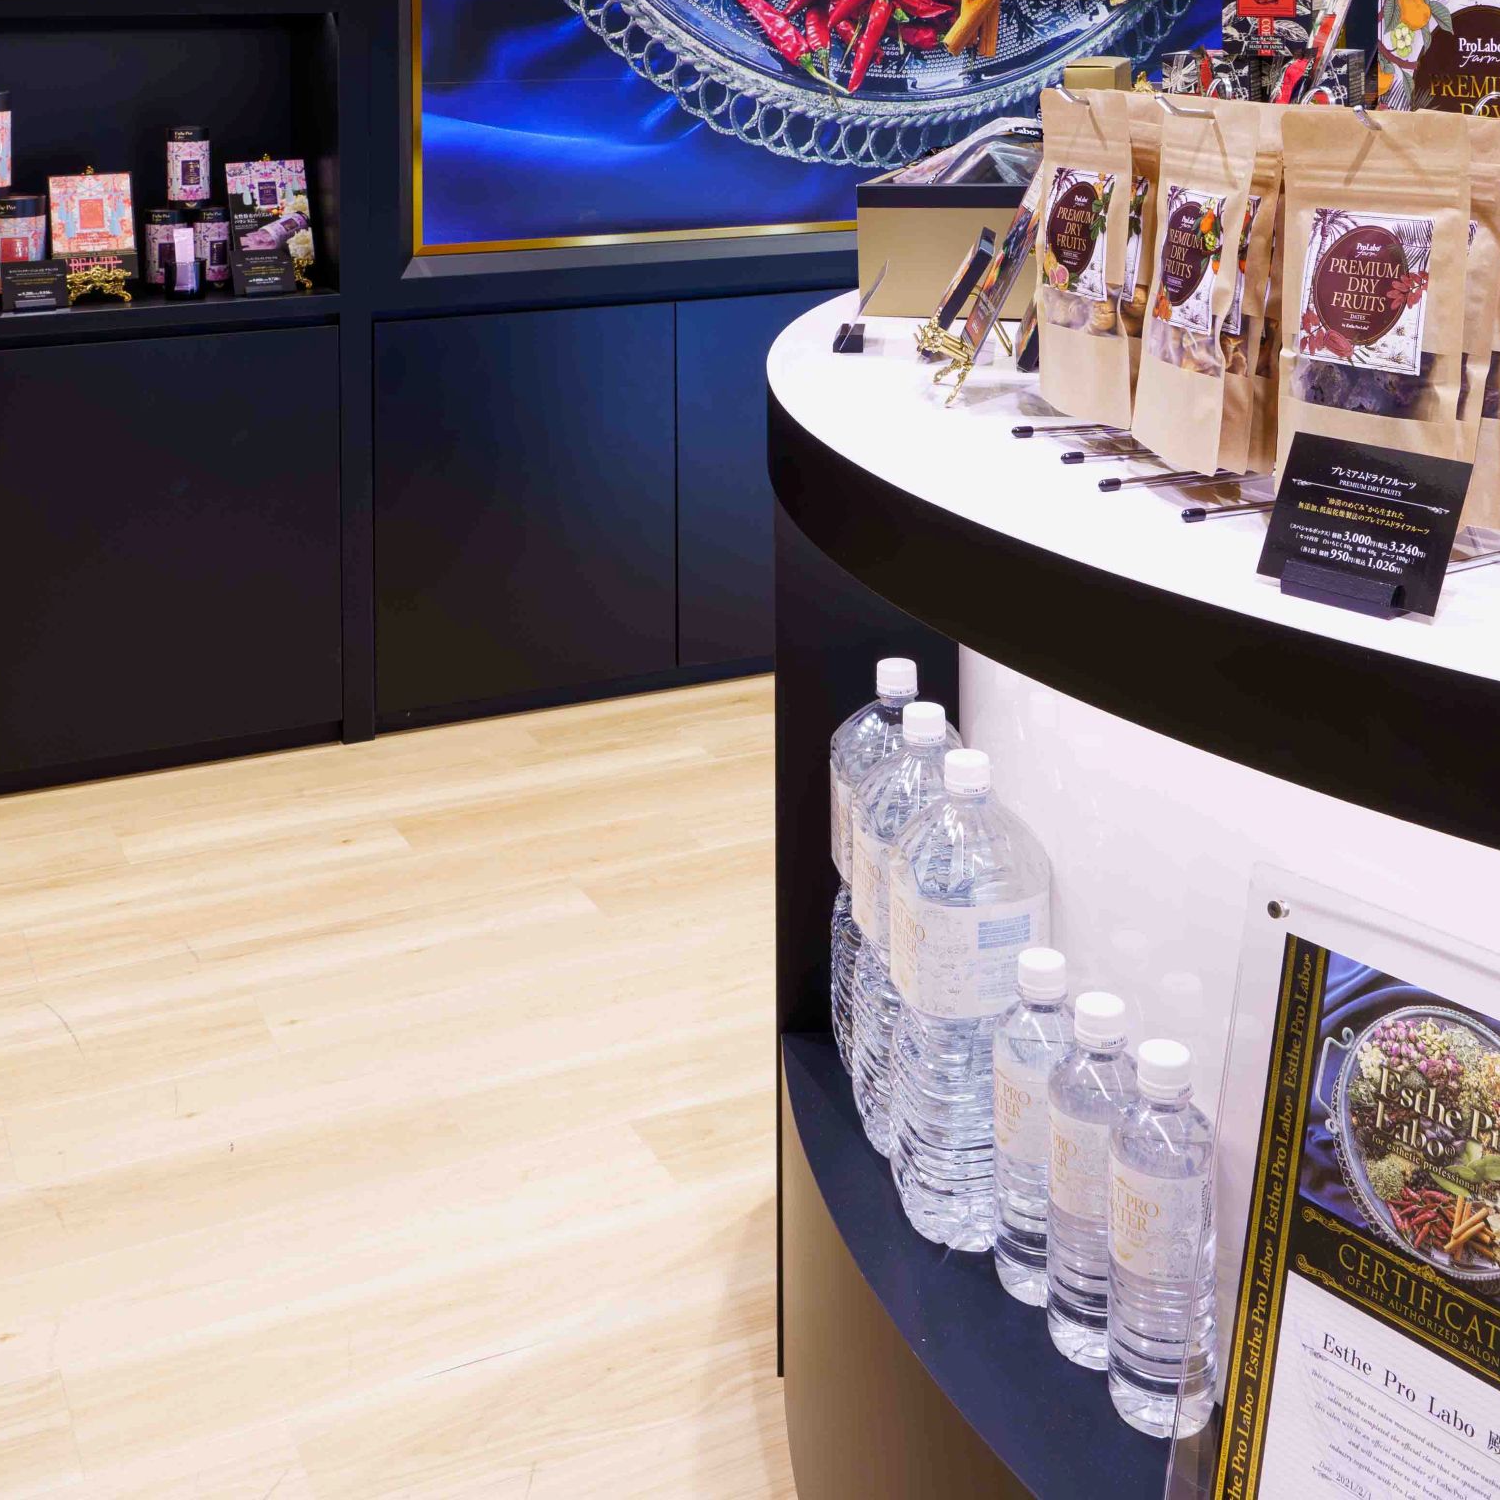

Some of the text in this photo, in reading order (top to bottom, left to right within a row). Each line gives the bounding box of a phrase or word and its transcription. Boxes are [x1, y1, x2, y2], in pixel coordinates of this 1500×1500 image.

[1459, 52, 1500, 68] farm
[1056, 206, 1097, 225] PREMIUM
[1064, 221, 1083, 236] DRY
[1056, 234, 1087, 251] FRUITS
[1170, 245, 1188, 260] DRY
[1163, 259, 1193, 279] FRUITS
[1330, 257, 1400, 279] PREMIUM
[1347, 276, 1379, 297] DRY
[1332, 291, 1386, 314] FRUITS
[1331, 466, 1417, 490] プレミアムドライフルーツ
[1339, 479, 1402, 497] PREMIUM DRY FRUITS
[1377, 1065, 1461, 1130] Esthe
[1385, 1140, 1422, 1164] esthetic
[1422, 1156, 1478, 1189] professional
[1126, 1195, 1159, 1218] PRO
[1347, 1275, 1500, 1369] OF THE AUTHORIZED SALON
[1322, 1334, 1372, 1379] Esthe
[1382, 1367, 1417, 1404] Pro
[1427, 1394, 1476, 1439] Labo
